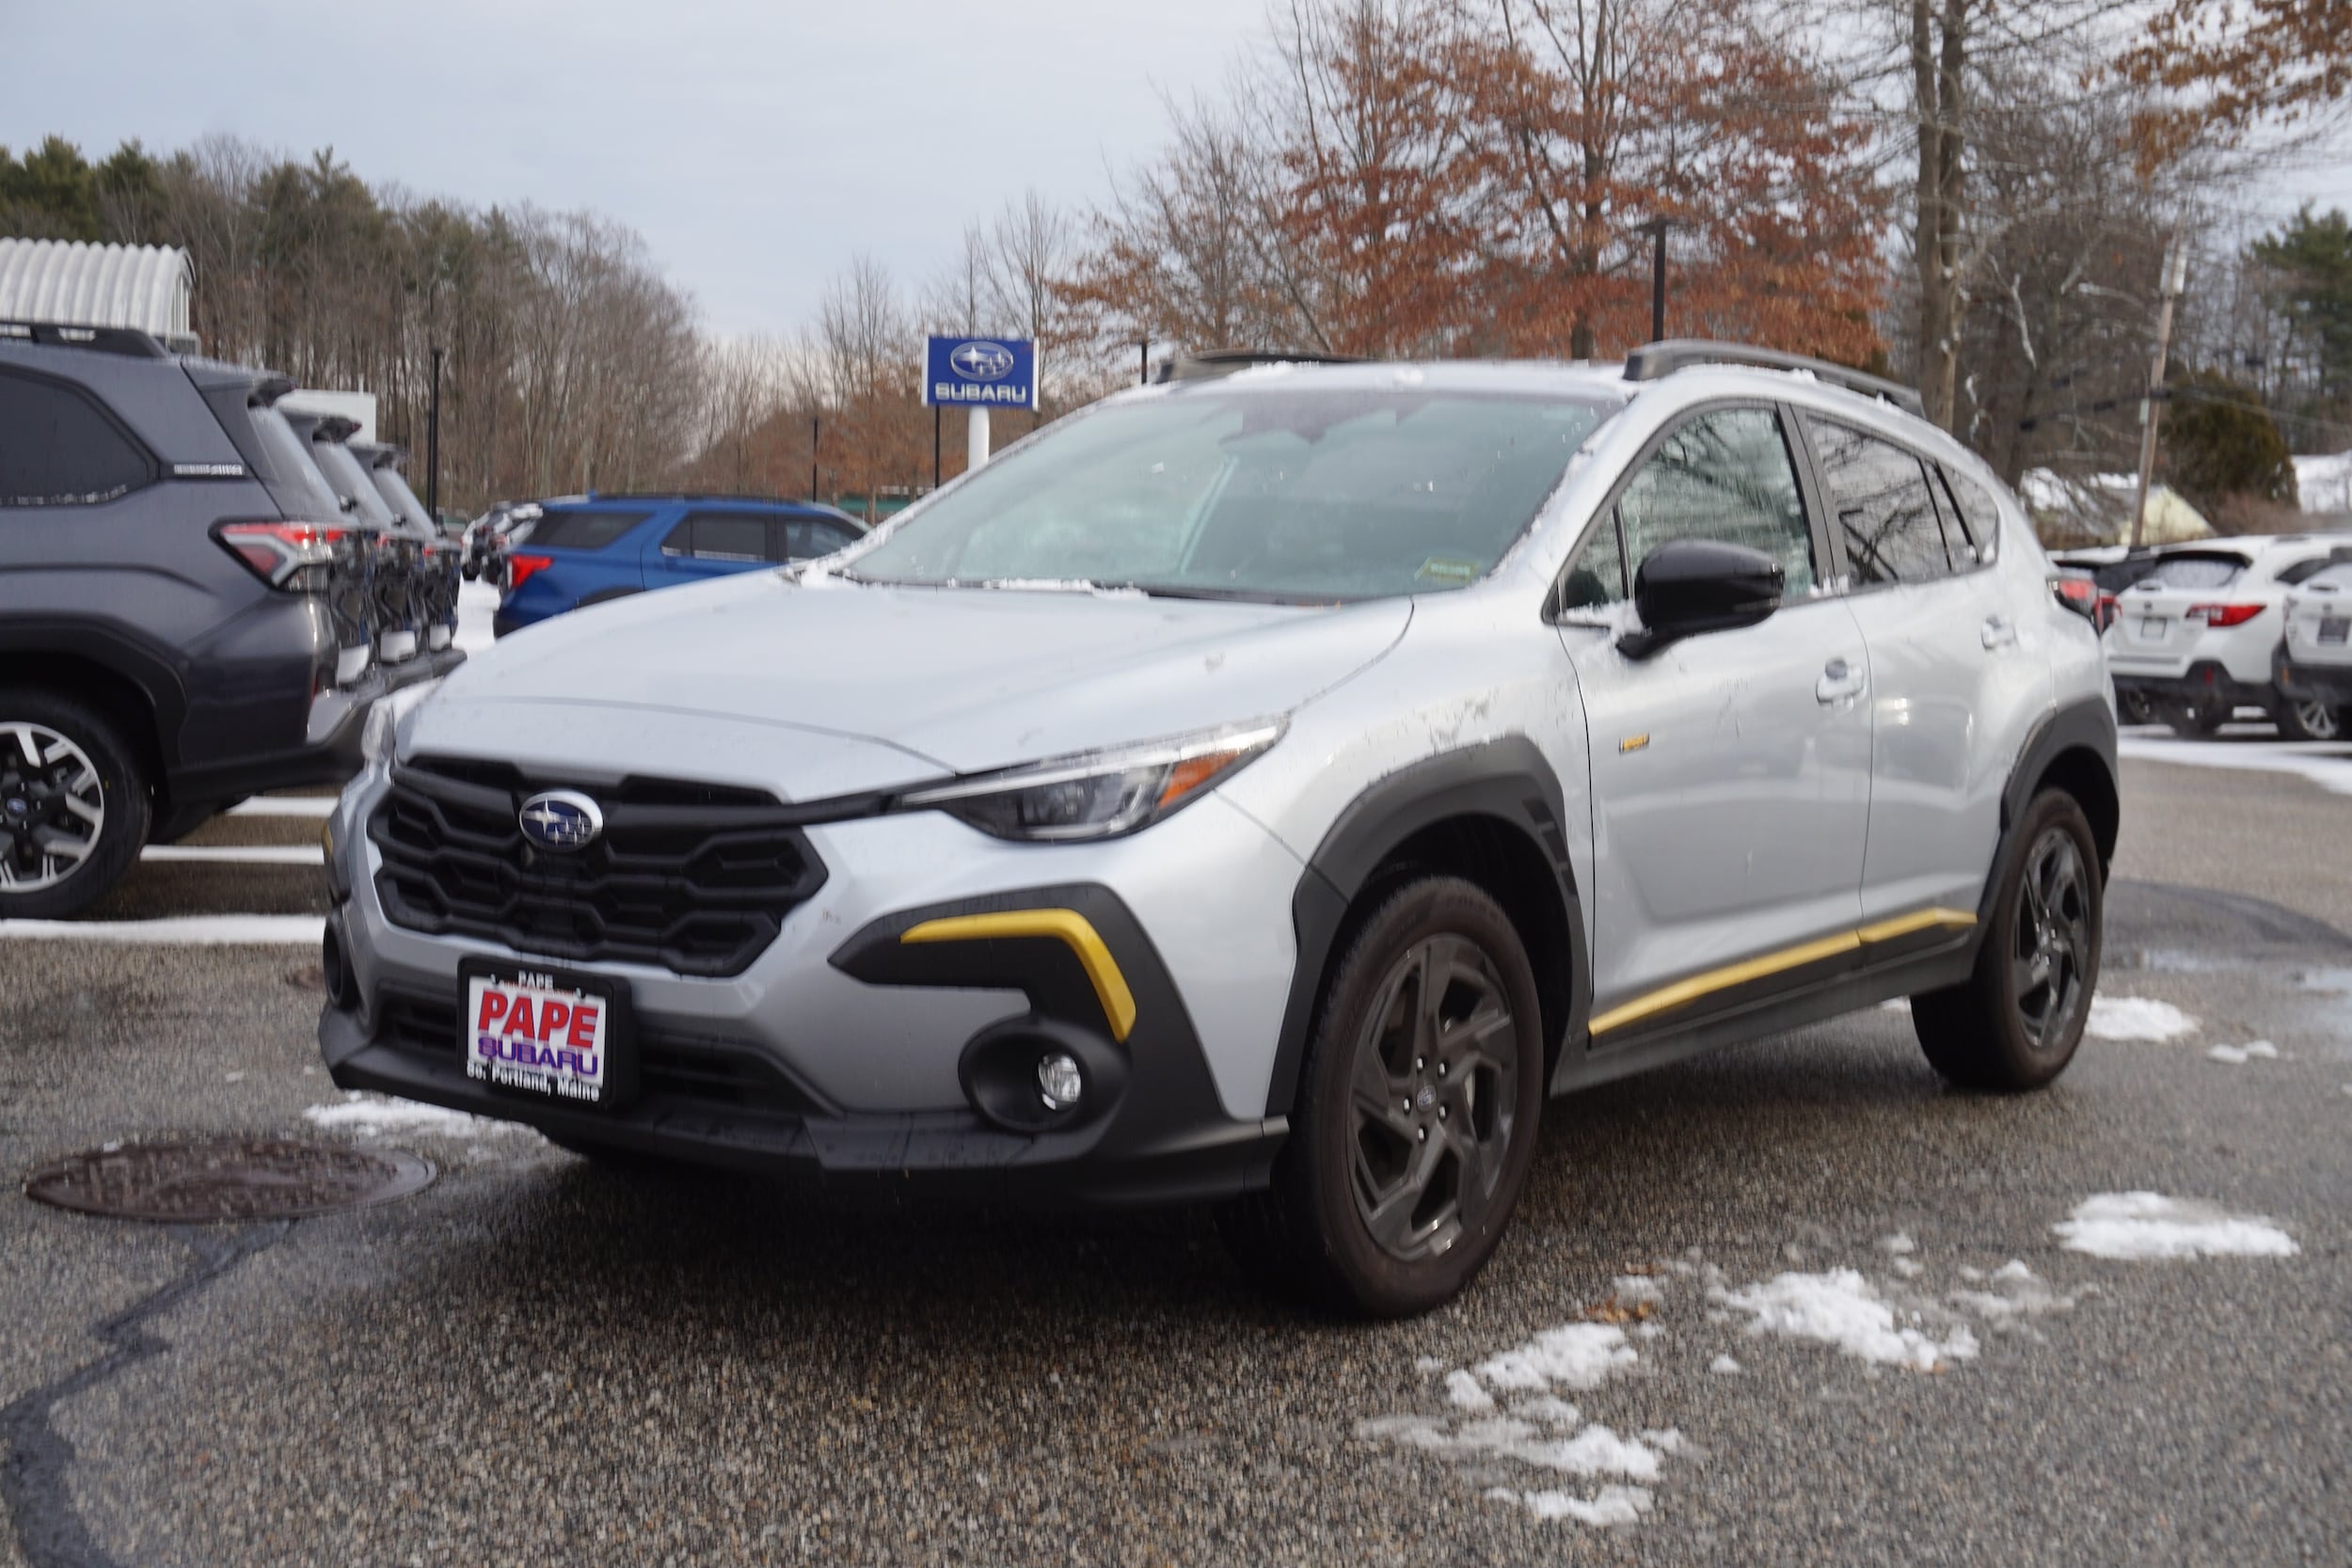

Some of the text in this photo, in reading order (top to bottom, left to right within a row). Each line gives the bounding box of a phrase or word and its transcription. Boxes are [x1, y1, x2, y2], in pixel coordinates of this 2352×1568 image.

[934, 382, 1026, 404] SUBARU
[477, 990, 599, 1050] PAPE
[478, 1037, 598, 1075] SUBARU
[491, 1063, 551, 1097] Portland,
[557, 1075, 600, 1102] Maine
